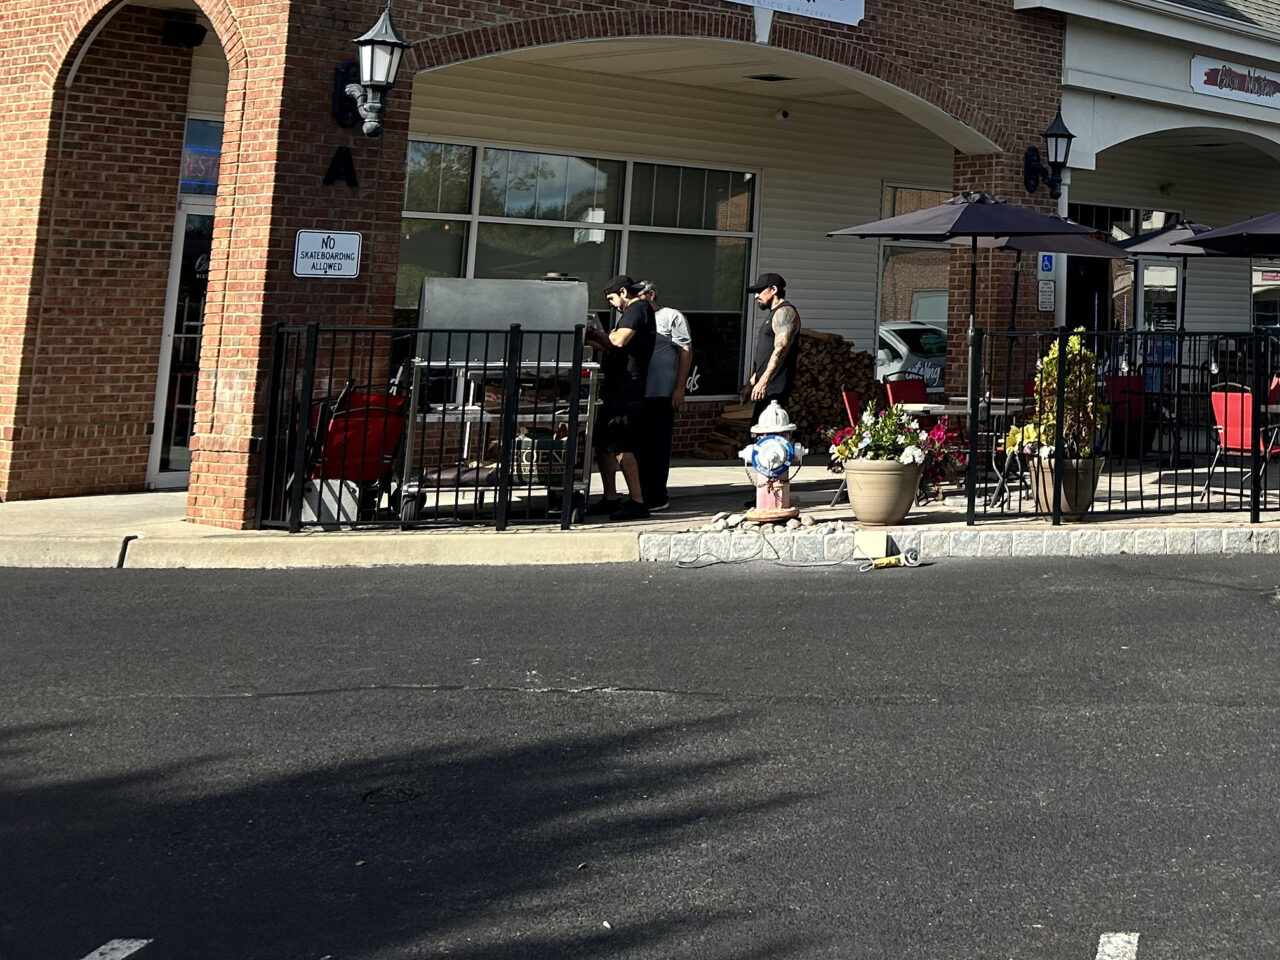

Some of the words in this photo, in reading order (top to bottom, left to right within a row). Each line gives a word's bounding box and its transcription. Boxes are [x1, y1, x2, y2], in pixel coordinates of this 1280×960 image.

[323, 147, 358, 187] A
[322, 237, 336, 250] NO
[300, 251, 355, 261] SKATEBOARDING
[311, 262, 342, 271] ALLOWED
